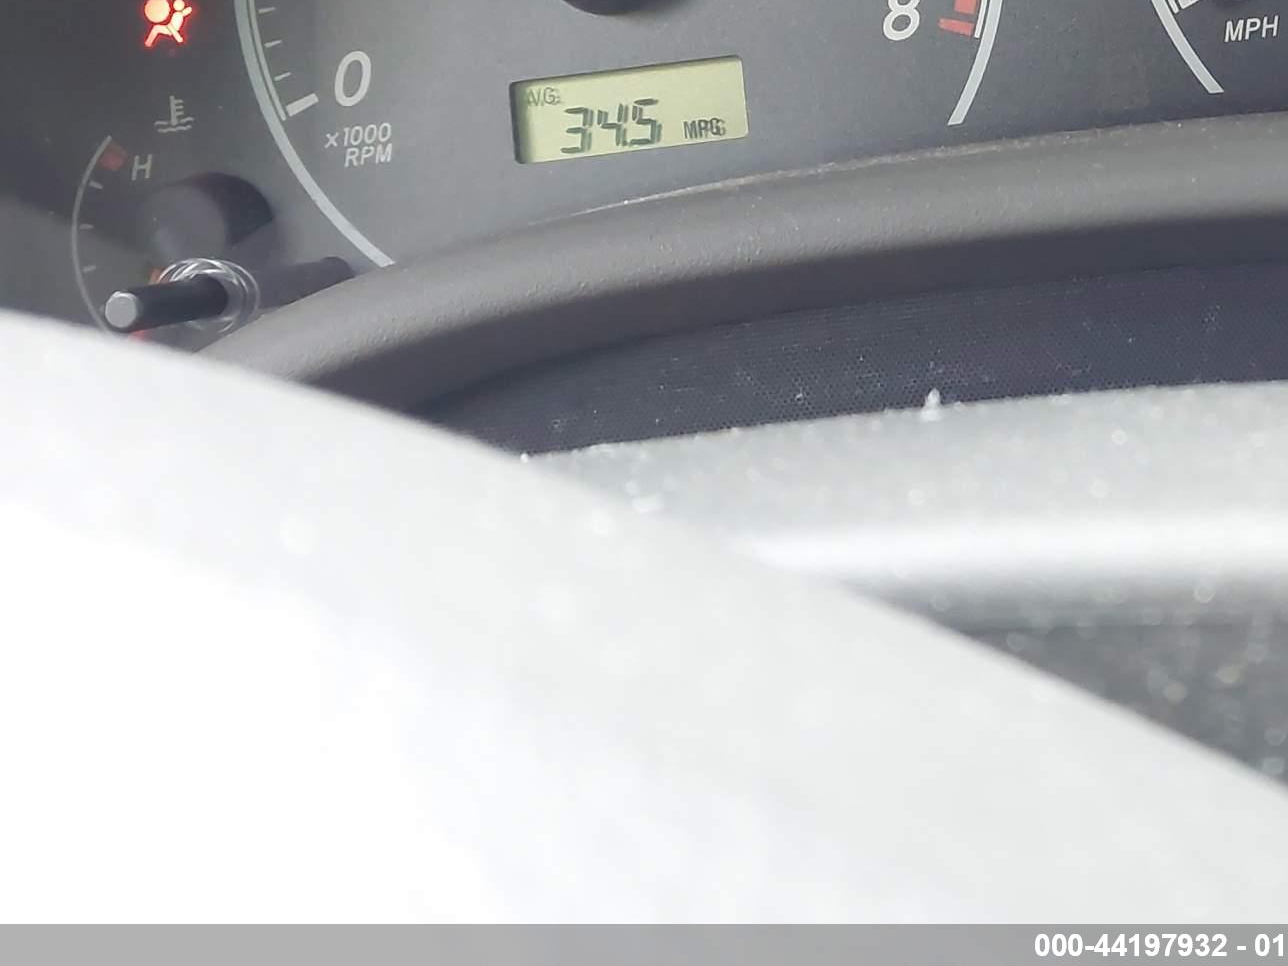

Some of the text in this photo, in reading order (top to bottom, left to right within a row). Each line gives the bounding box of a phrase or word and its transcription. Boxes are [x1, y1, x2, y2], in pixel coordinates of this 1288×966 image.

[1224, 15, 1279, 42] MPH
[334, 50, 371, 107] 0
[683, 117, 726, 139] MPG
[132, 154, 152, 180] H
[345, 144, 393, 168] RPM
